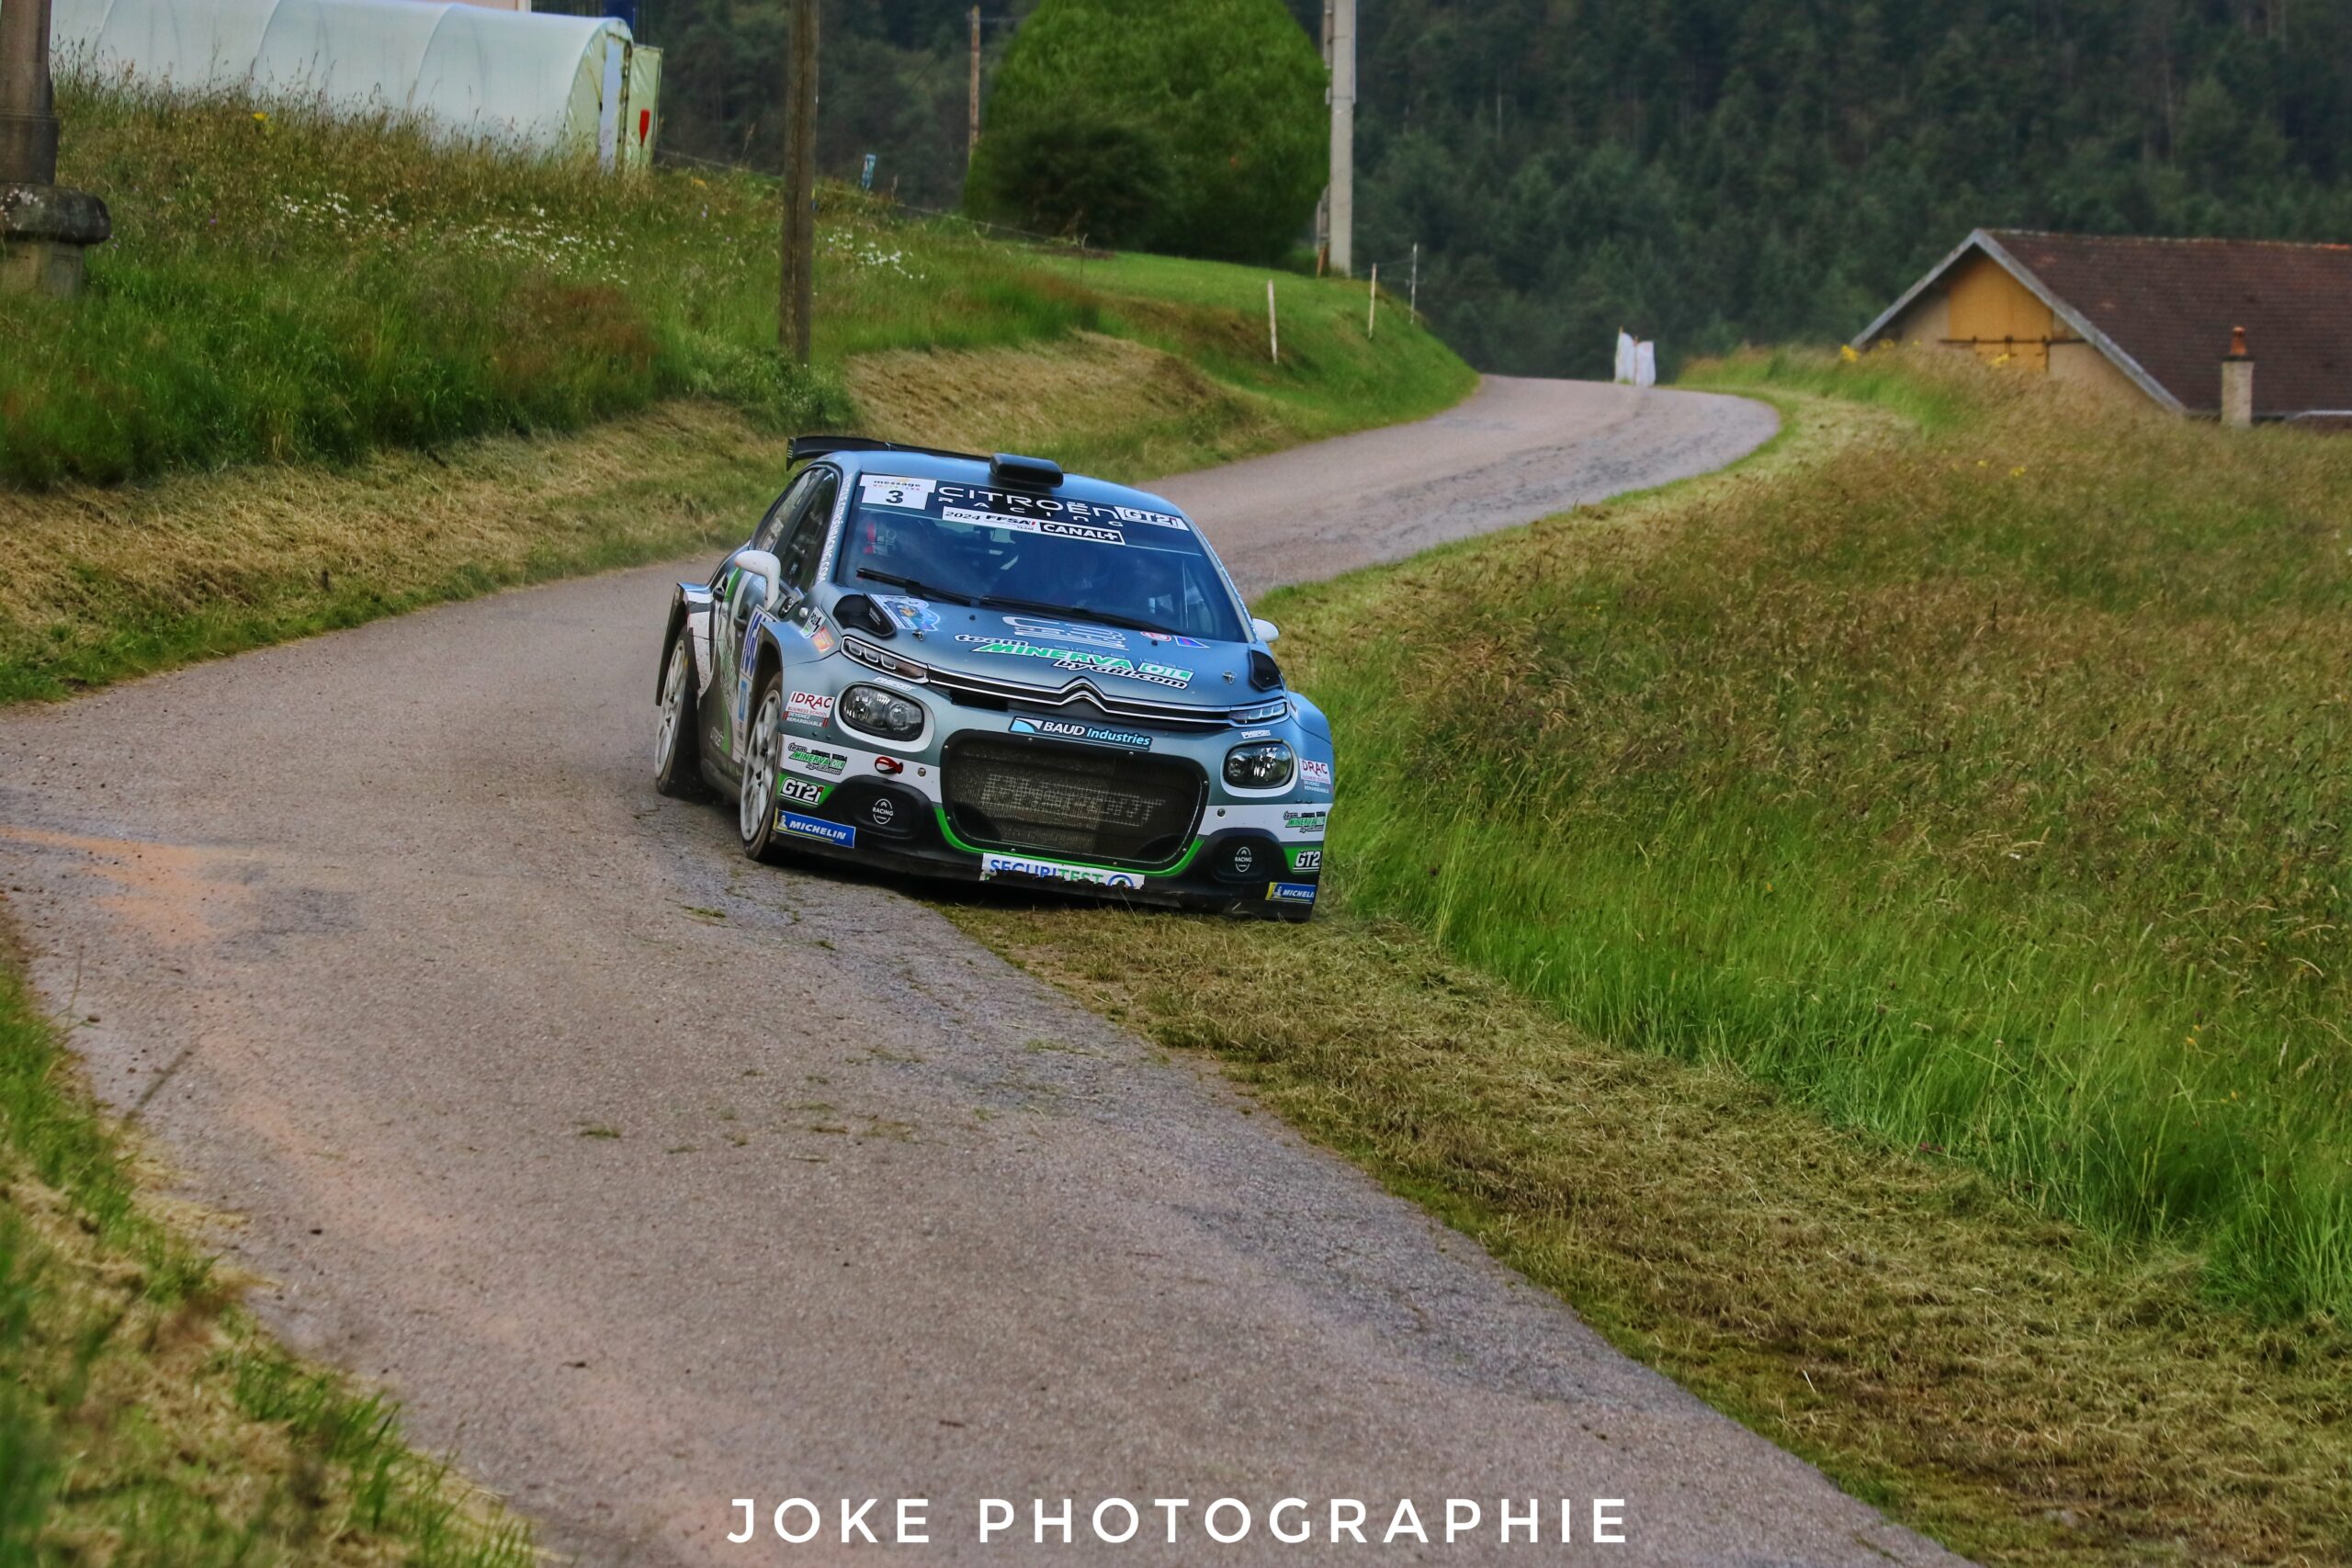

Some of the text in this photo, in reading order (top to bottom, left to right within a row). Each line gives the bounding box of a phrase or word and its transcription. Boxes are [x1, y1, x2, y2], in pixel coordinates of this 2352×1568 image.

[874, 479, 922, 488] message
[885, 490, 904, 504] 3
[944, 511, 981, 521] 2024
[1043, 524, 1118, 541] CANAL+
[1125, 508, 1178, 527] GT2i
[955, 634, 1030, 647] team
[974, 643, 1135, 671] MINERVA
[1137, 662, 1194, 682] OIL
[1054, 659, 1088, 671] by
[791, 692, 832, 710] IDRAC
[1043, 721, 1152, 746] BAUD Industries
[788, 742, 808, 753] team
[790, 750, 831, 766] MINERVA
[830, 758, 847, 771] OIL
[782, 778, 824, 803] GT2i
[872, 807, 894, 817] RACING
[789, 820, 847, 840] MICHELIN
